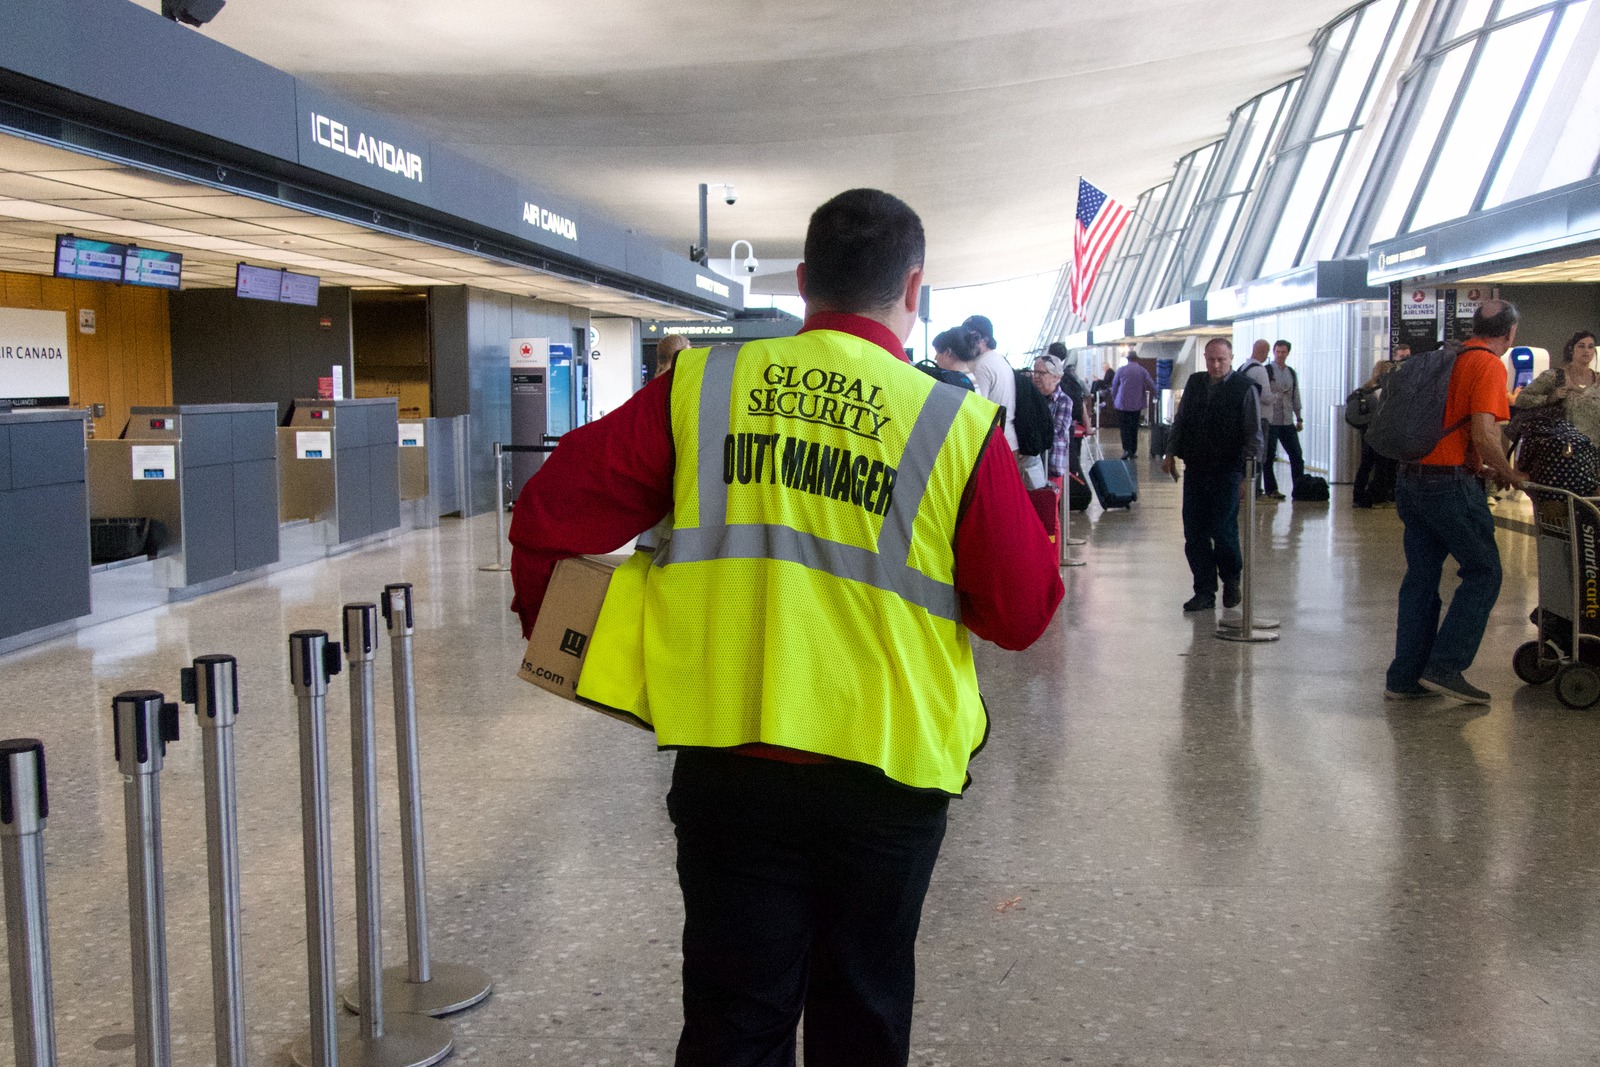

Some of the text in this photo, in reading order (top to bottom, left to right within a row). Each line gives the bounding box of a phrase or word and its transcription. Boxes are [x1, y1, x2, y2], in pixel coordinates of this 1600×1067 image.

[310, 112, 424, 184] ICELANDAIR
[523, 202, 577, 241] AIR CANADA
[0, 346, 63, 360] IR CANADA
[663, 326, 734, 335] NEWSSTAND
[763, 363, 885, 411] GLOBAL
[748, 388, 892, 437] SECURITY
[723, 432, 899, 518] DUTY MANAGER
